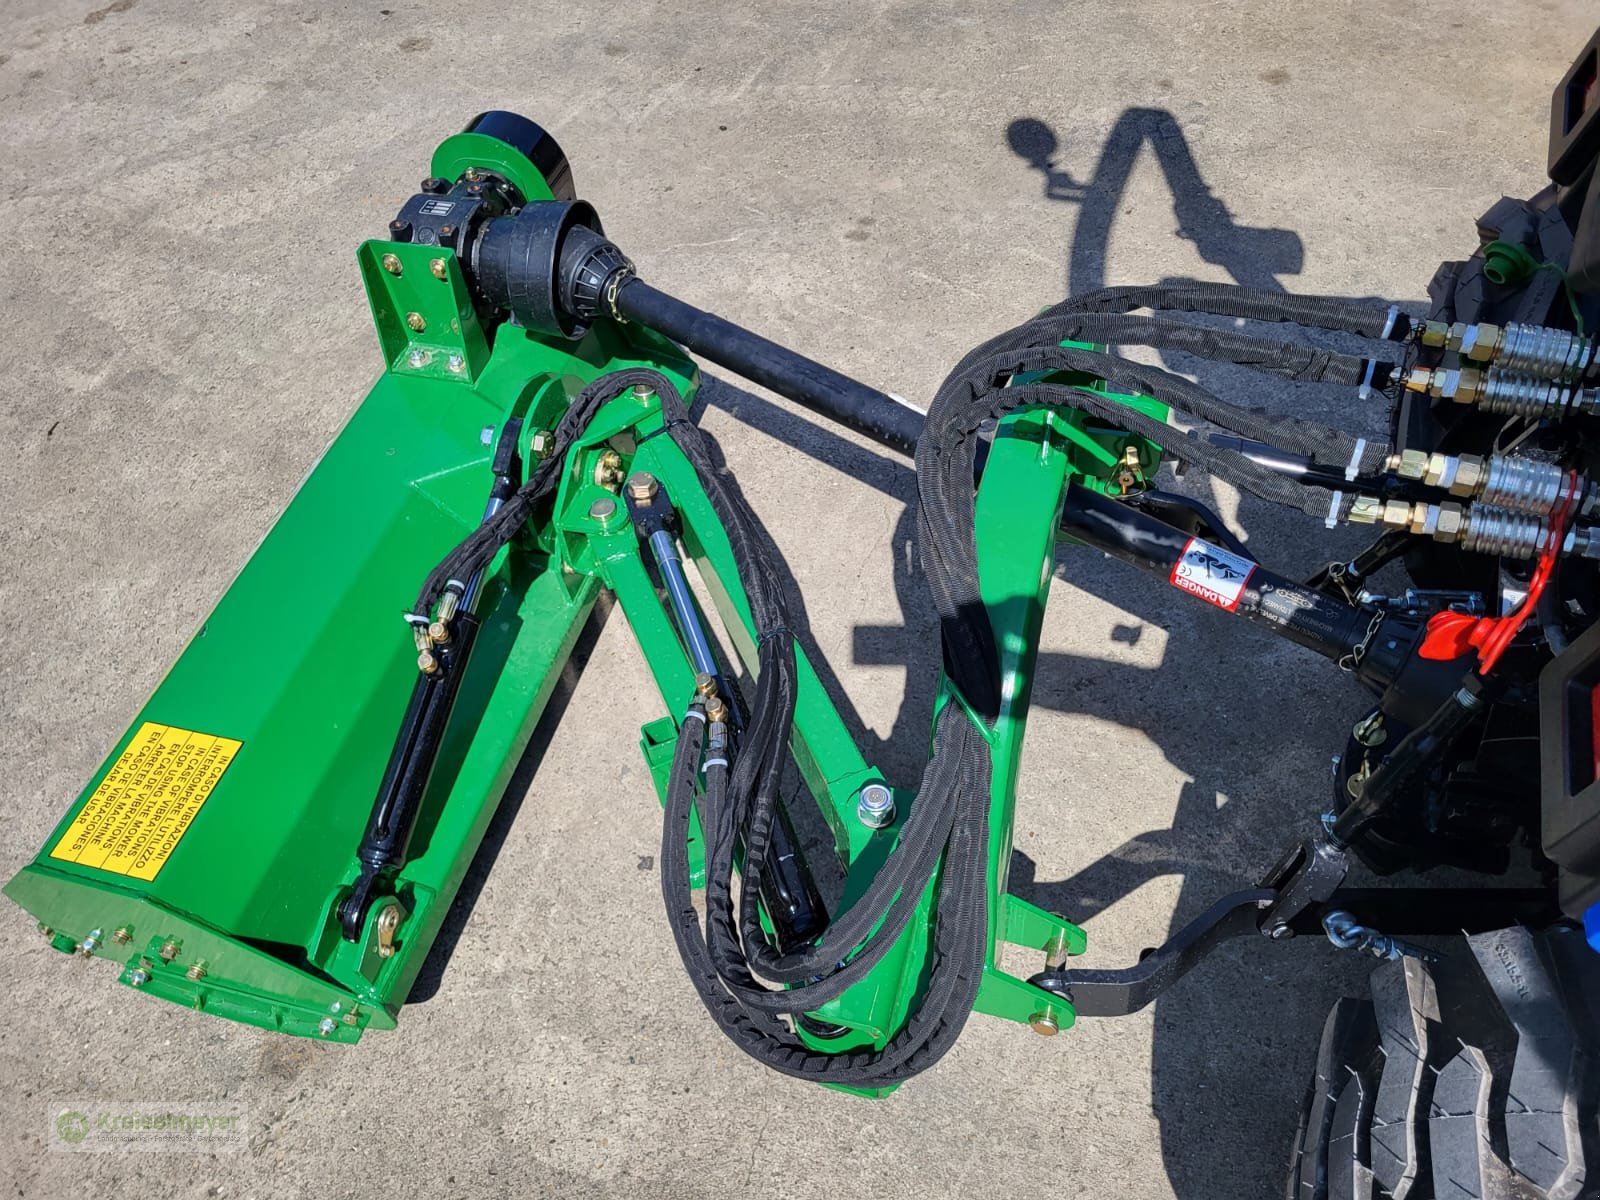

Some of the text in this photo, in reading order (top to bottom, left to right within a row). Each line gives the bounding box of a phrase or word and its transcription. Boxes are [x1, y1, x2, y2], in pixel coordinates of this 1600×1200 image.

[1175, 575, 1218, 601] DANGER
[145, 731, 162, 744] EN
[126, 745, 152, 771] CASO
[165, 743, 181, 755] EN
[193, 747, 207, 756] IN
[151, 756, 172, 776] CAS
[216, 755, 230, 764] IN
[116, 771, 133, 785] DE
[175, 757, 200, 783] CASE
[198, 766, 223, 792] CASO
[75, 752, 133, 824] DEJAR DE USAR
[141, 777, 158, 791] DE
[166, 784, 182, 798] OF
[89, 743, 167, 846] ARRETER LA MACHINE
[111, 743, 196, 858] STOP USING THE MOWER
[190, 793, 205, 804] DI
[133, 744, 223, 869] INTERROMPERE L'UTILIZZO
